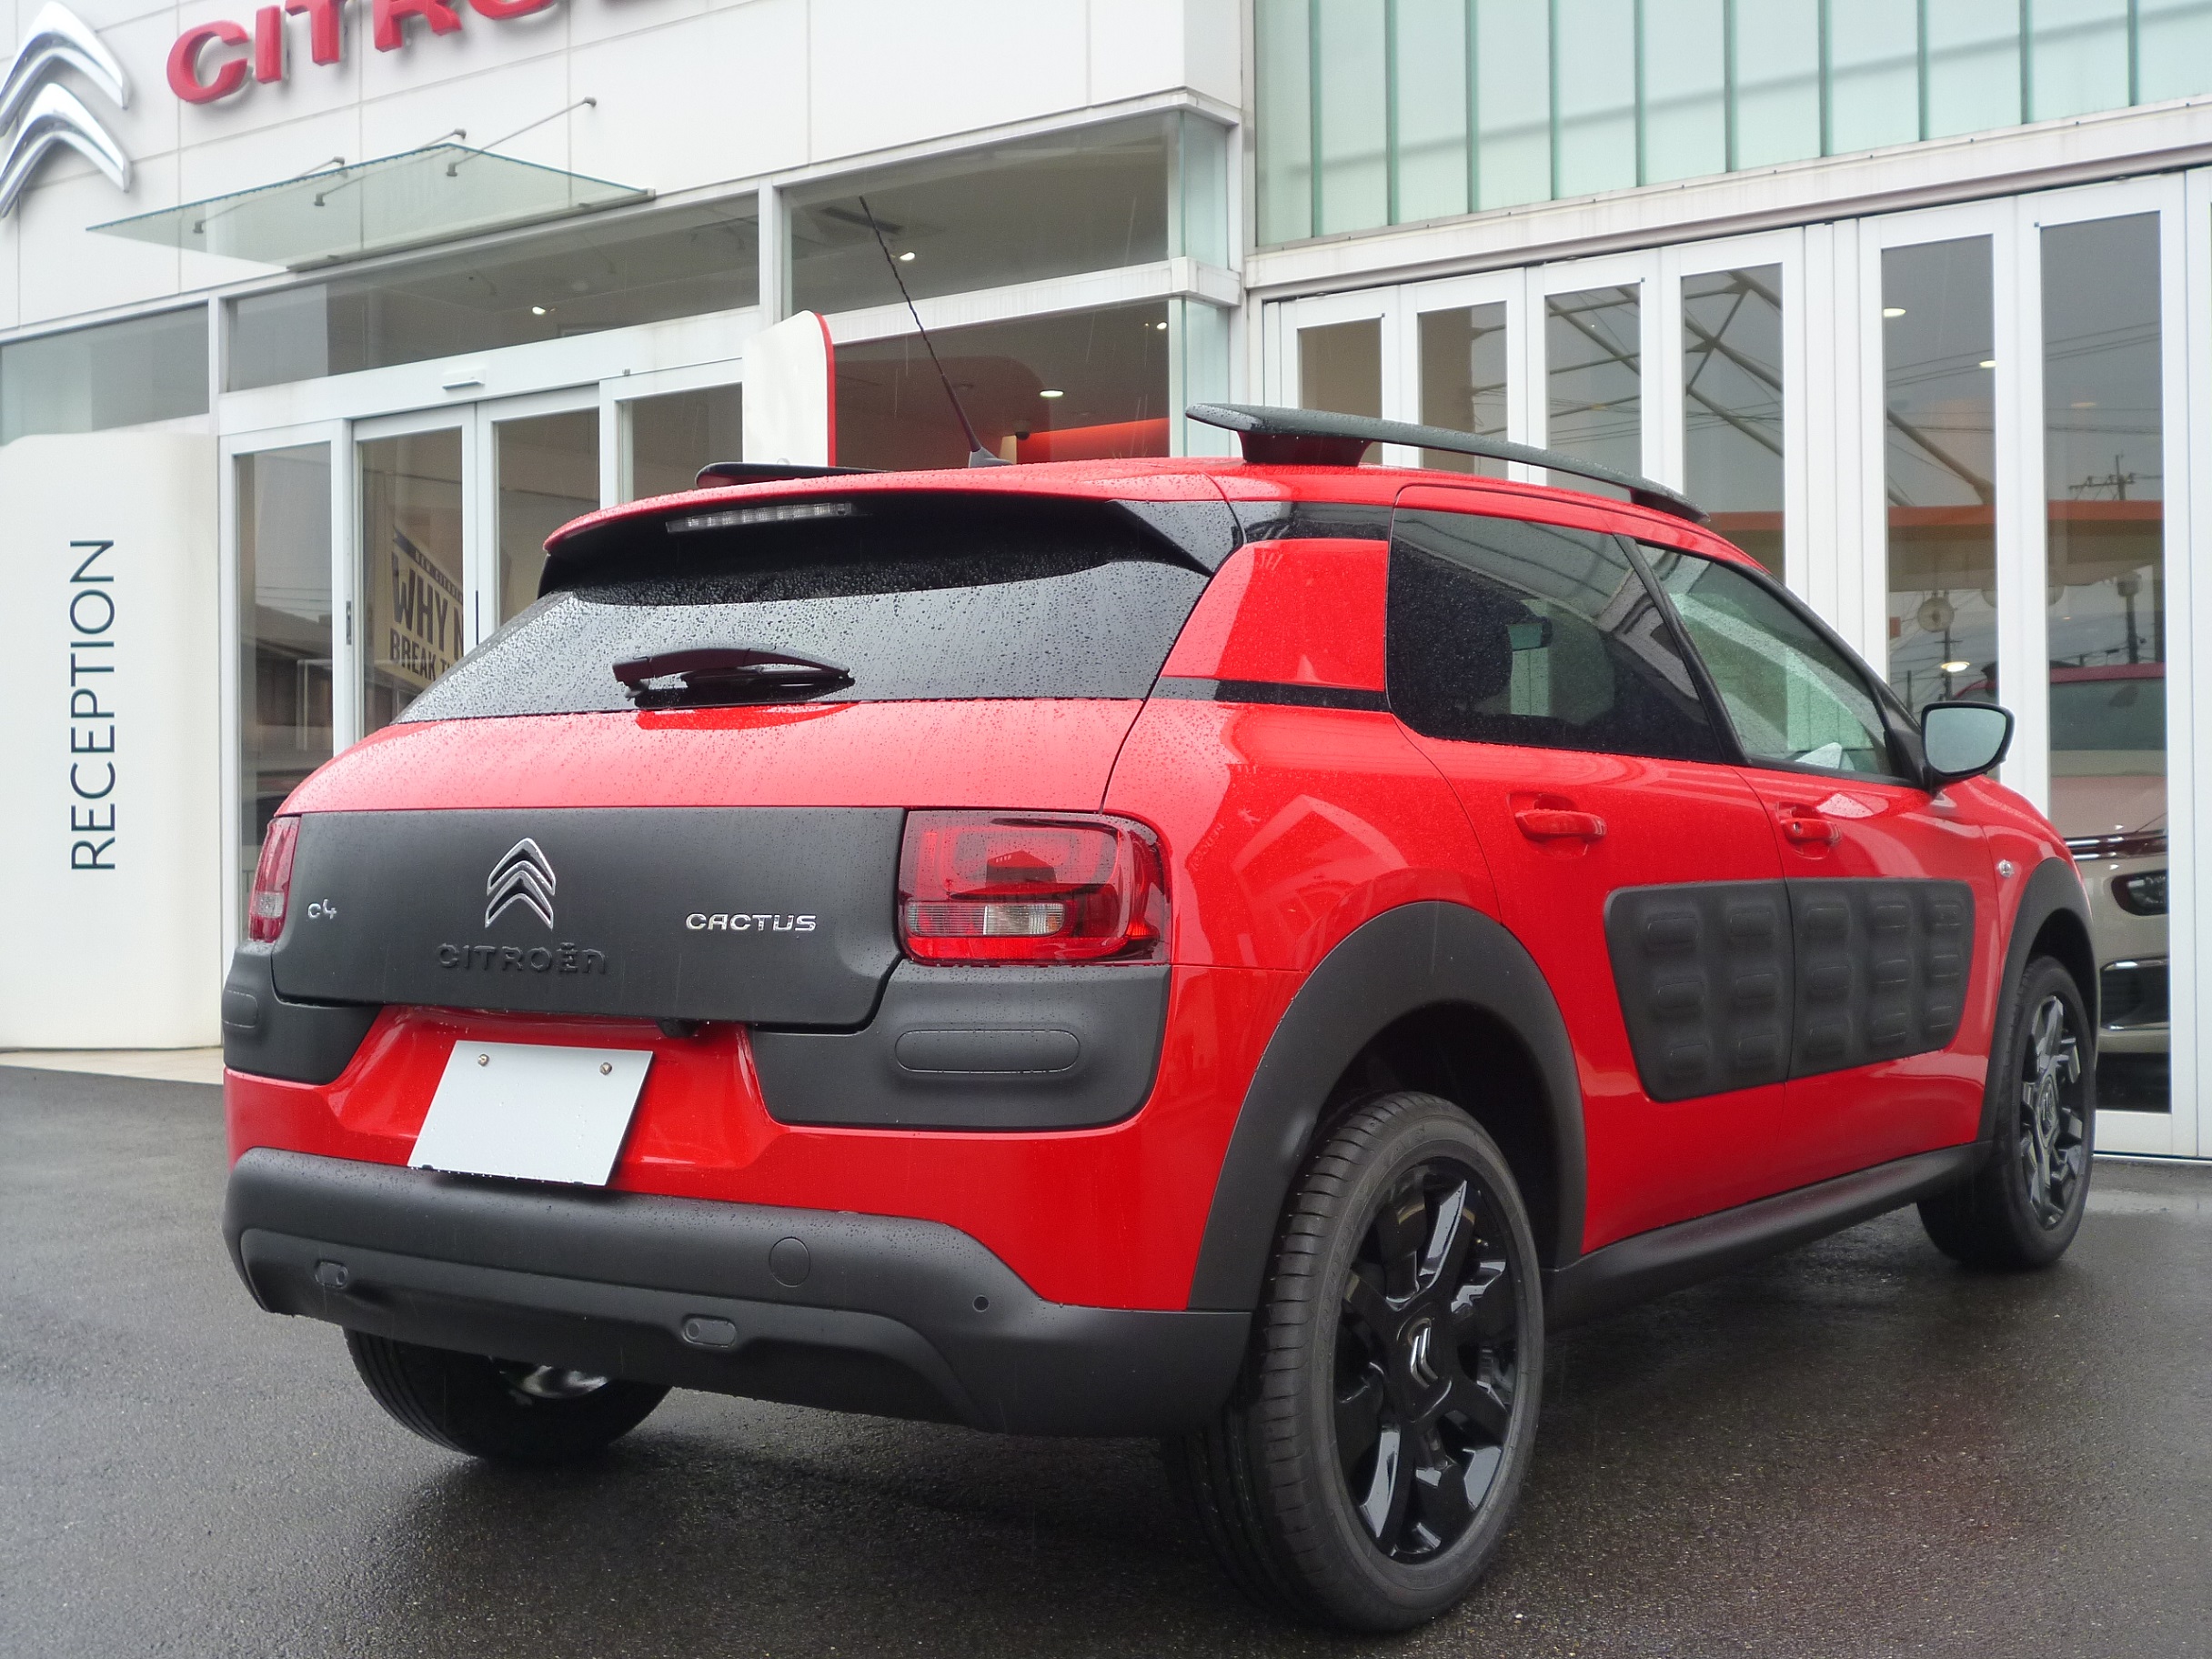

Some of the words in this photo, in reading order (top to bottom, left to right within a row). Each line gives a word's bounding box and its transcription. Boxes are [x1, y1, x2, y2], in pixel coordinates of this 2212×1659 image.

[166, 0, 553, 105] CITR
[391, 551, 448, 652] WHY
[69, 539, 116, 870] RECEPTION
[390, 628, 437, 682] BREAK
[685, 913, 817, 931] CACTUS
